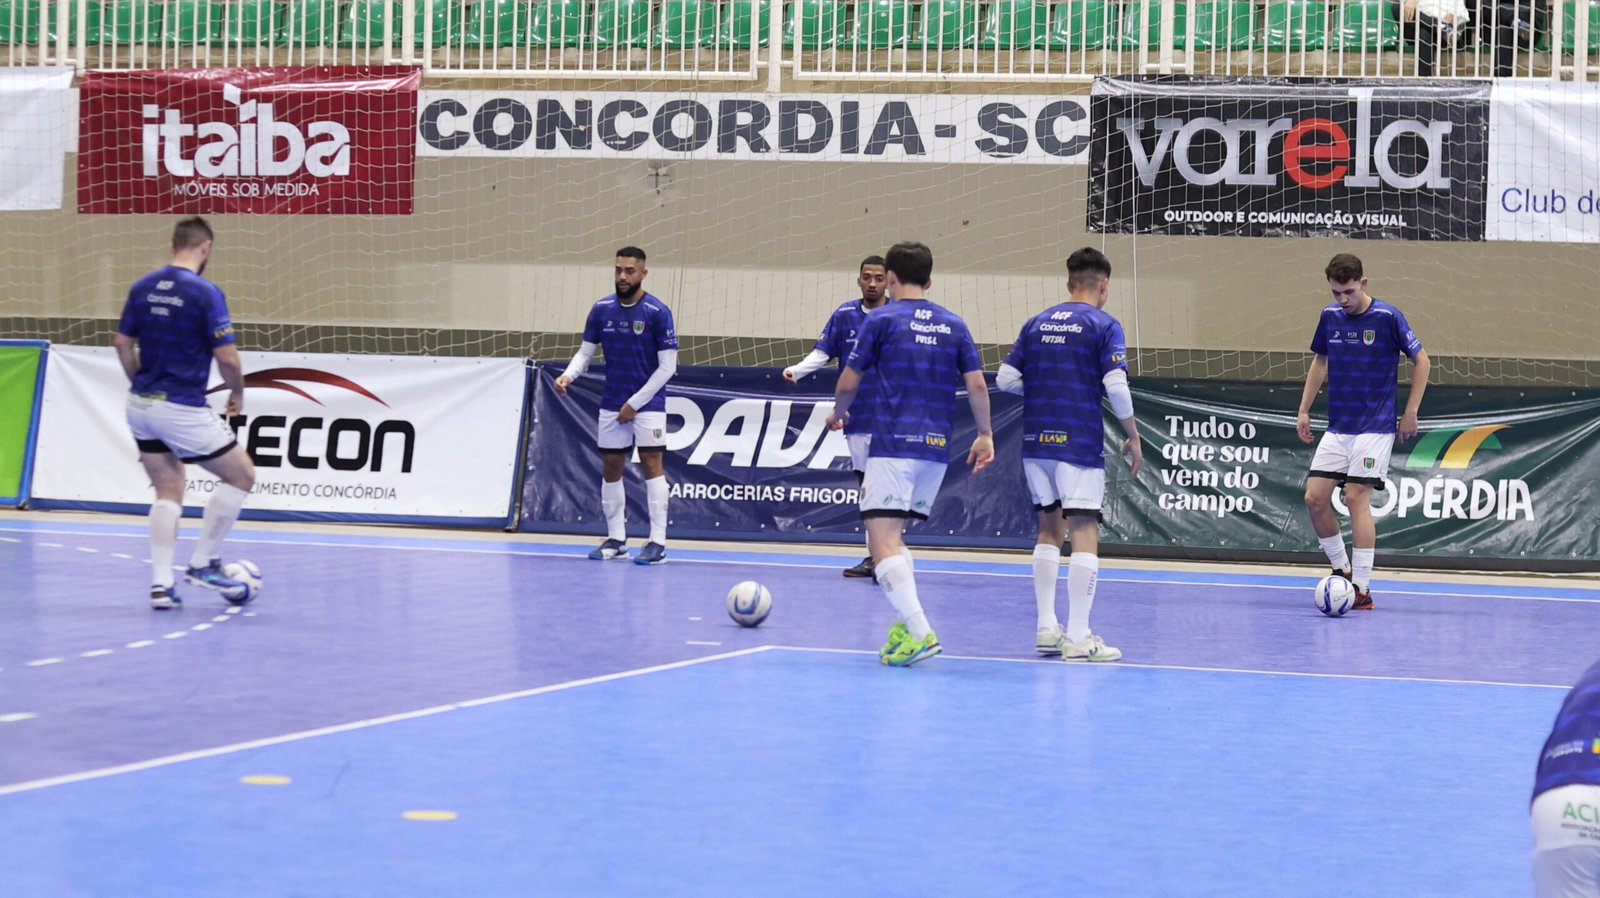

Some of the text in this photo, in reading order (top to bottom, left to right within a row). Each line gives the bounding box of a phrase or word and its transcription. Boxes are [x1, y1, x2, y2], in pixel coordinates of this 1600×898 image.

[975, 100, 1090, 158] SC
[1116, 88, 1452, 189] varela
[175, 181, 319, 196] MÓVEIS SOB MEDIDA
[1501, 187, 1566, 214] Club
[1164, 210, 1407, 228] OUTDOOR E COMUNICAÇÃO VISUAL
[914, 308, 933, 320] ACF
[1050, 310, 1073, 321] ACF
[1165, 415, 1256, 440] Tudo o
[1162, 443, 1270, 466] que sou
[1160, 466, 1260, 489] vem do
[248, 483, 310, 498] IMENTO
[313, 483, 397, 500] CONCÓRDIA
[667, 482, 785, 502] ARROCERIAS
[1158, 492, 1254, 518] campo
